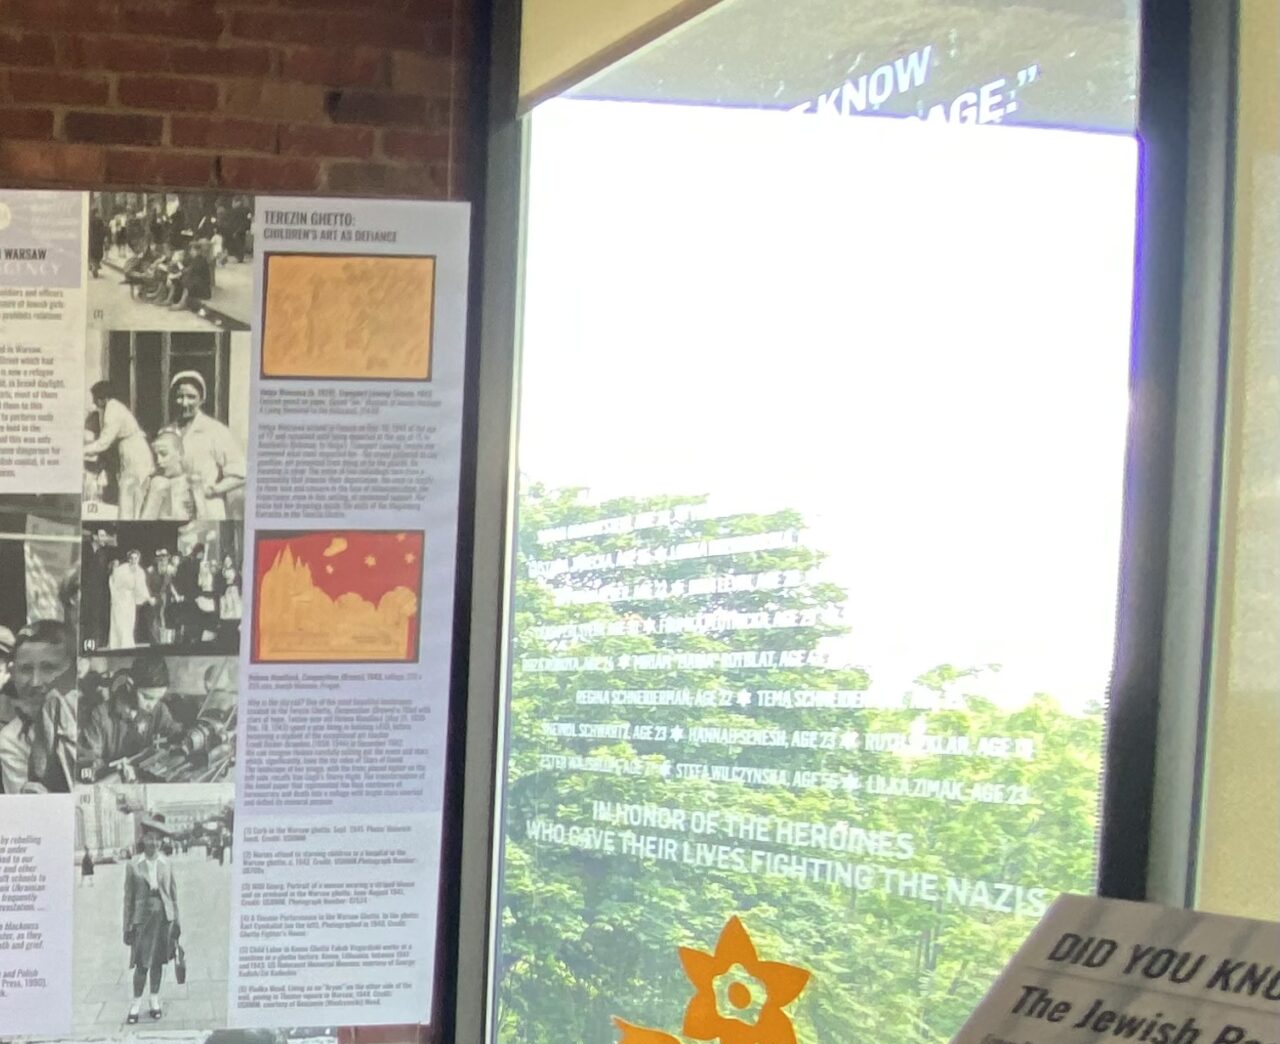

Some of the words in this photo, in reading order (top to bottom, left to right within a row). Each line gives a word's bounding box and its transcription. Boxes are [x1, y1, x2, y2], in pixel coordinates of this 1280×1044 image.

[818, 46, 931, 115] KNOW
[264, 210, 307, 225] TEREZIN
[264, 228, 317, 240] CHILDREN'S
[320, 230, 337, 240] ART
[341, 230, 352, 241] AS
[355, 231, 397, 242] DEFIANCE
[4, 248, 46, 260] WARSAW
[84, 639, 95, 651] (4)
[634, 724, 651, 741] AGE
[654, 726, 667, 741] 23
[593, 800, 612, 821] IN
[616, 803, 686, 832] HONOR
[691, 810, 719, 835] OF
[725, 815, 770, 842] THE
[777, 821, 914, 860] HEROINES
[527, 820, 565, 844] WHO
[619, 831, 678, 861] THEIR
[682, 841, 746, 871] LIVES
[751, 850, 870, 890] FIGHTING
[884, 869, 939, 902] THE
[948, 876, 1047, 918] NAZIS
[1047, 933, 1118, 968] DID
[1123, 944, 1207, 984] YOU
[1012, 985, 1072, 1023] The
